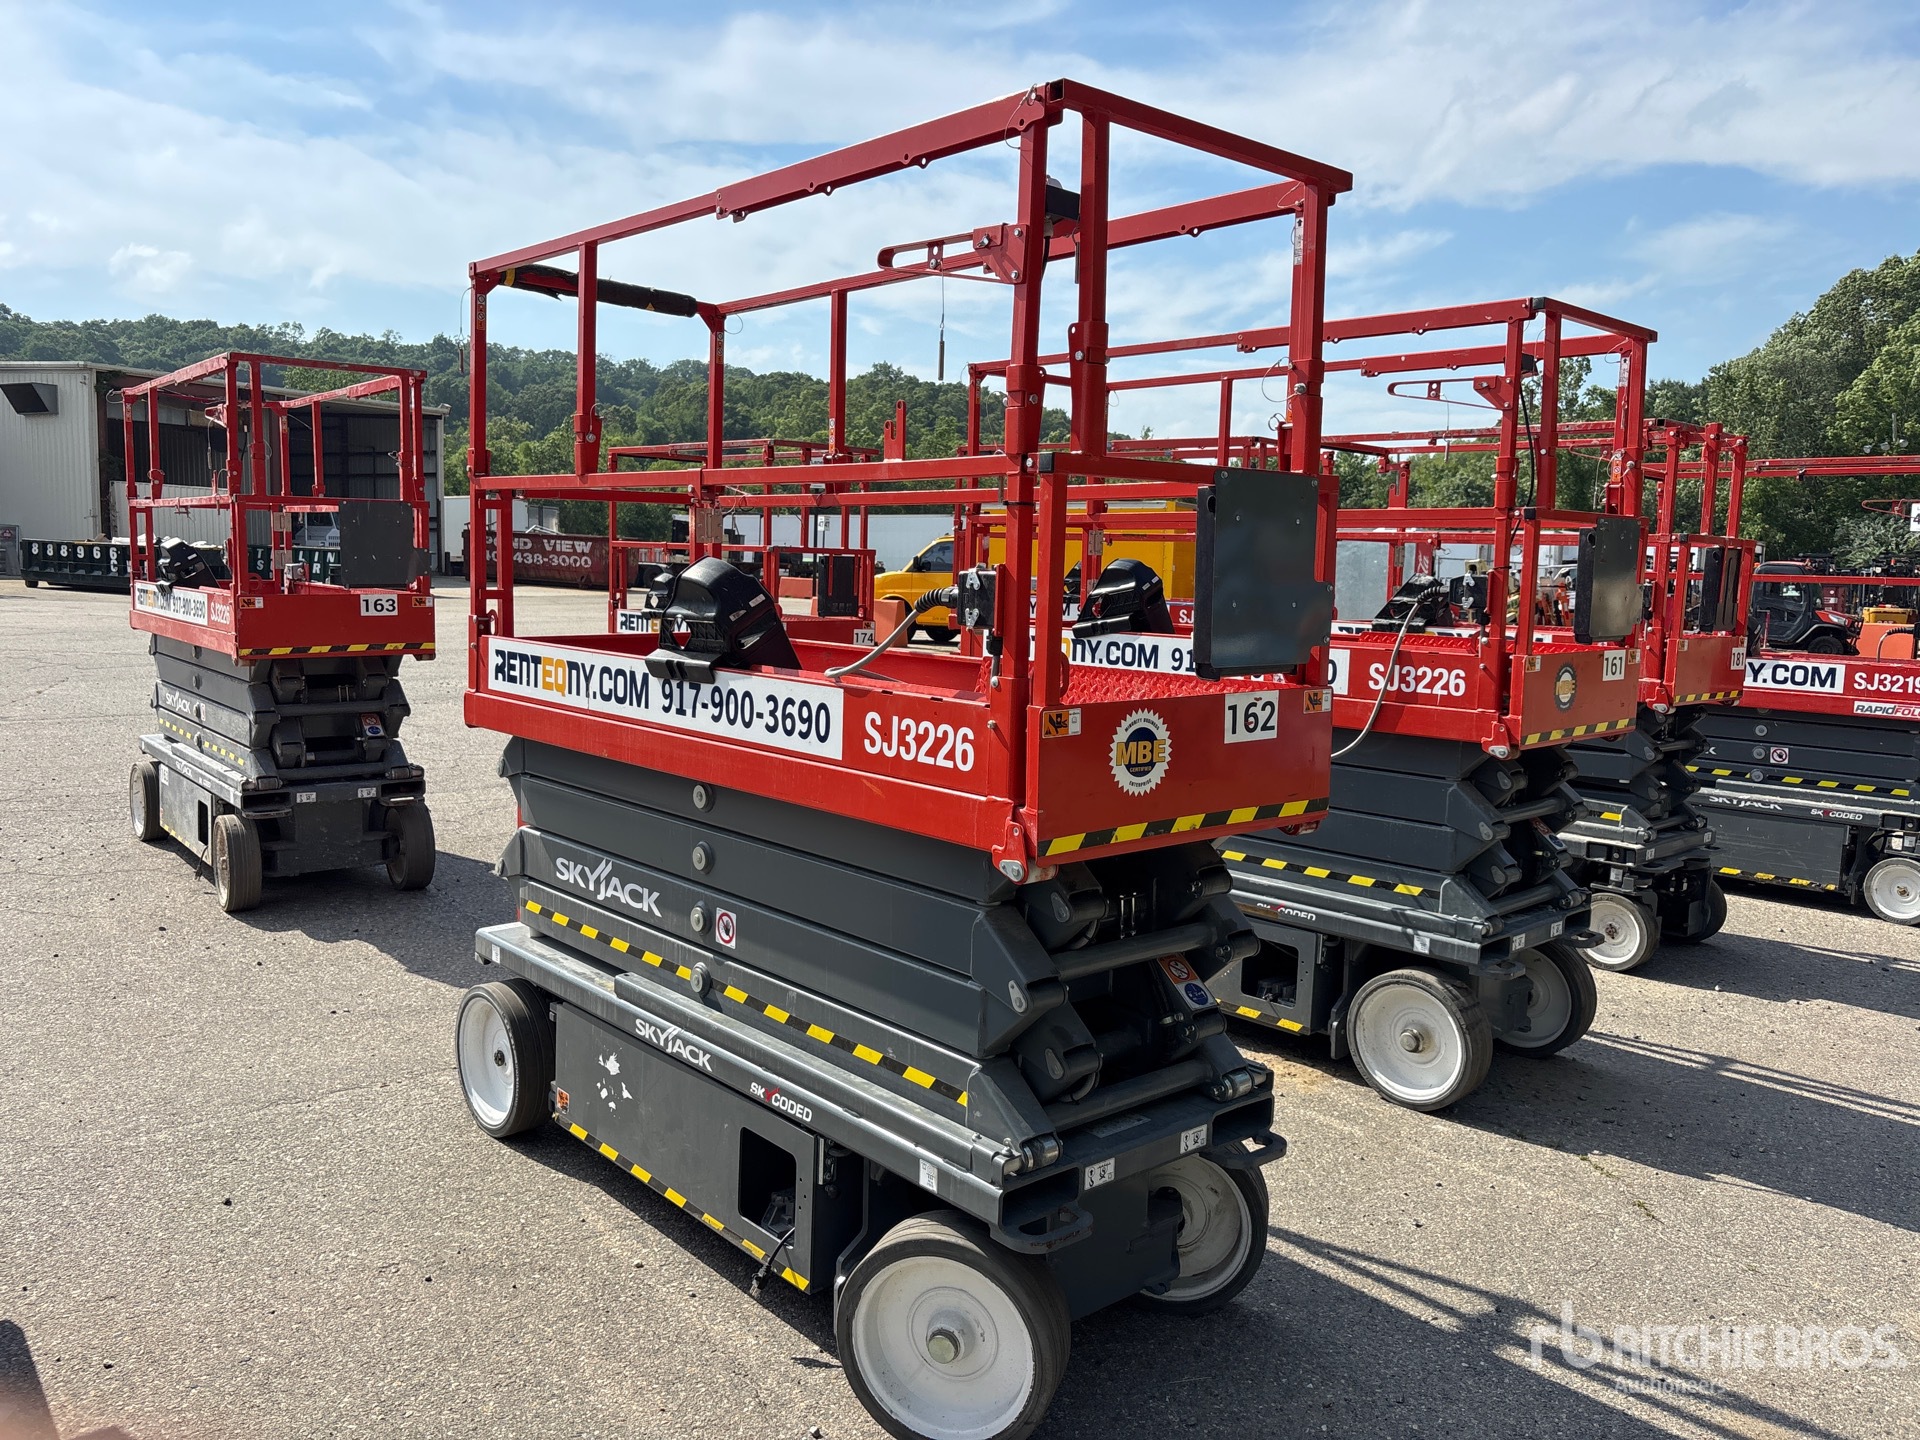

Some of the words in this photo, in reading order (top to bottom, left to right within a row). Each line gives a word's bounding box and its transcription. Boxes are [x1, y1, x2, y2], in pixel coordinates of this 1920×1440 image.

[543, 539, 592, 553] VIEW
[210, 601, 230, 624] SJ3226
[362, 598, 396, 613] 163
[855, 632, 873, 643] 174
[1604, 657, 1622, 676] 161
[1732, 652, 1744, 667] 181
[494, 648, 650, 709] RENTEQNY.COM
[661, 679, 831, 743] 917-900-3690
[1368, 663, 1466, 697] SJ3226
[1228, 700, 1276, 735] 162
[864, 711, 975, 772] SJ3226
[1116, 738, 1167, 767] MBE
[555, 857, 663, 918] SKYJACK
[635, 1018, 713, 1072] SKYJACK
[750, 1081, 813, 1122] SKYCODED
